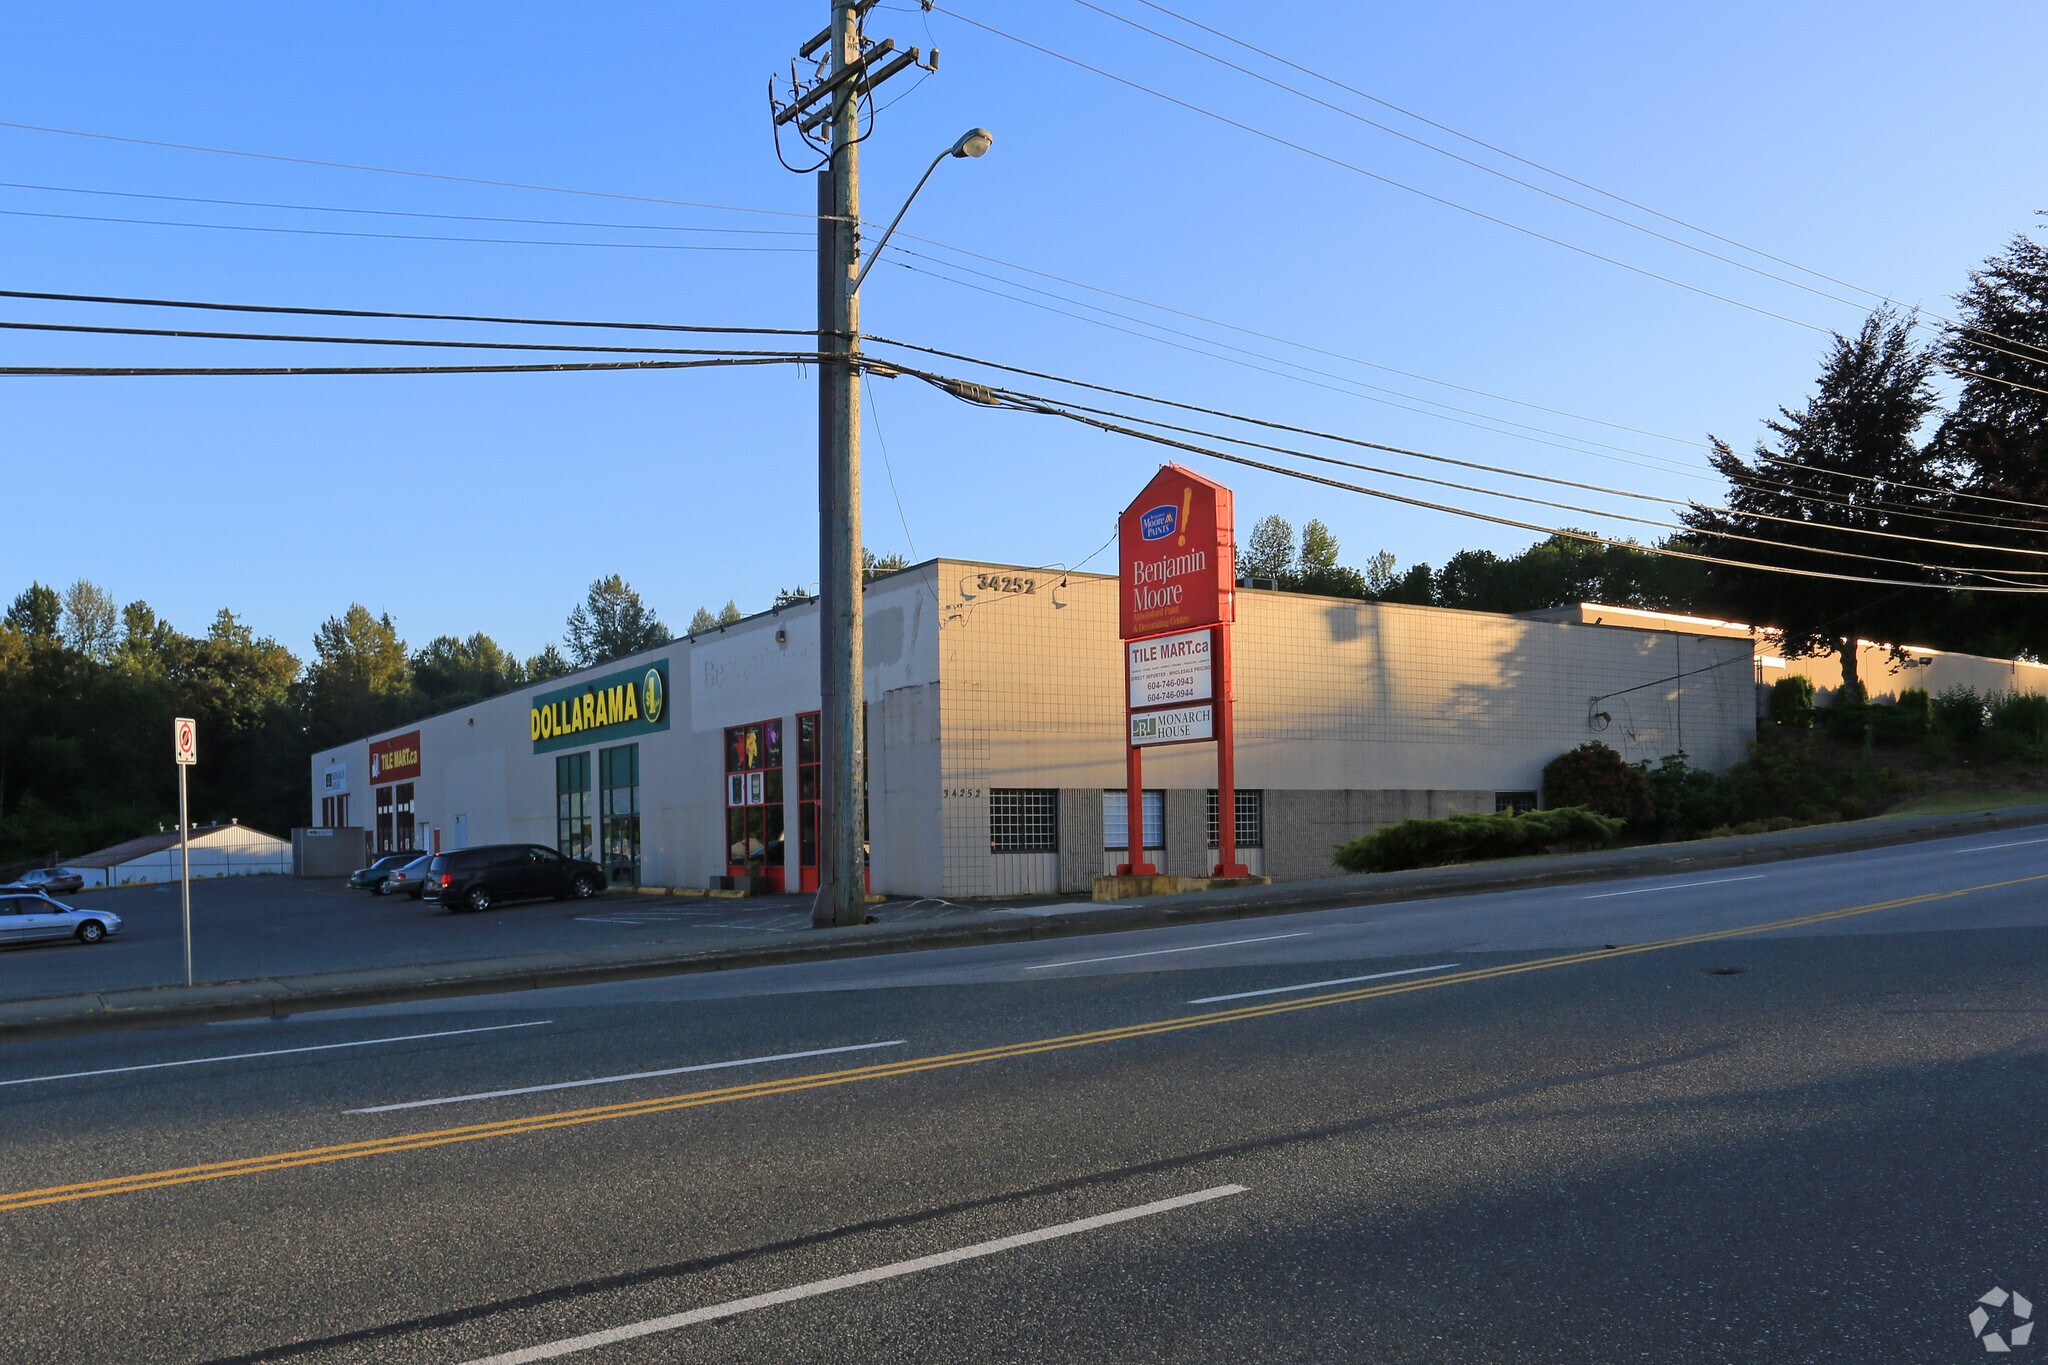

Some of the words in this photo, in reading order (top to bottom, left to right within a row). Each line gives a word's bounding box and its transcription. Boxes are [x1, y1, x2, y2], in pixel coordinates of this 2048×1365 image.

[1143, 517, 1165, 529] Moore
[1147, 524, 1170, 537] PAINTS
[1133, 548, 1206, 585] Benjamin
[977, 573, 1036, 594] 34252
[1133, 584, 1183, 612] Moore
[1133, 646, 1157, 663] TILE
[1160, 640, 1209, 659] MART.ca
[1146, 672, 1166, 680] IMPORTER
[1169, 668, 1194, 676] WHOLESALE
[1194, 665, 1212, 673] PRICING
[1147, 676, 1194, 691] 604-746-0943
[1147, 688, 1194, 702] 604-746-0944
[530, 682, 638, 741] DOLLARAMA
[1158, 709, 1211, 727] MONARCH
[1158, 724, 1191, 738] HOUSE
[381, 752, 394, 770] TILE
[393, 747, 418, 769] MART.ca
[943, 789, 981, 798] 34252
